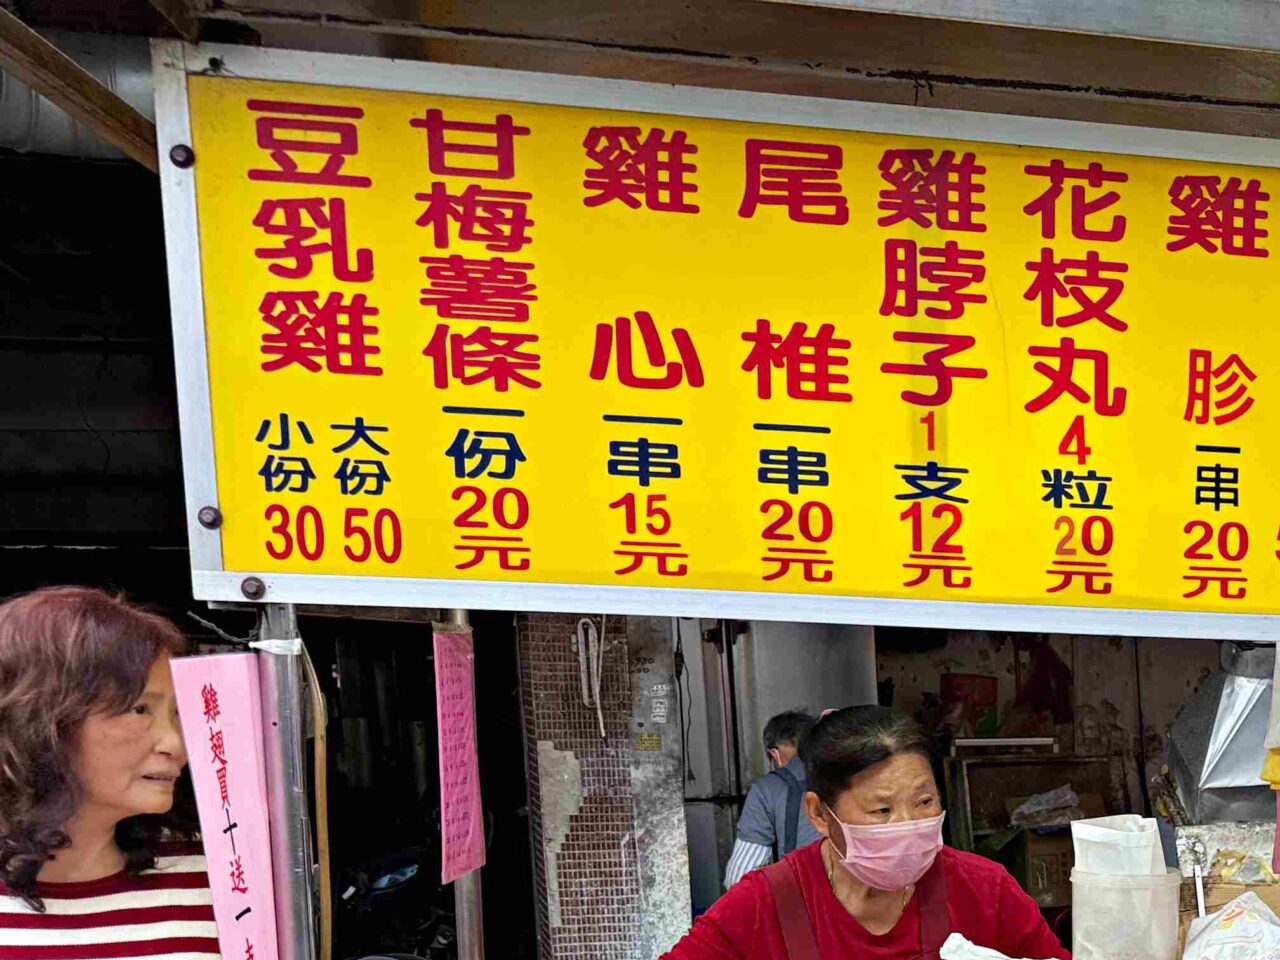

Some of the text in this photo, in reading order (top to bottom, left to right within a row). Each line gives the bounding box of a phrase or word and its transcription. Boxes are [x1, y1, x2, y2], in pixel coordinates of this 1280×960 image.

[246, 99, 402, 564] 豆乳雞 小份 30 大份 50
[410, 108, 542, 393] 甘梅薯條
[582, 126, 705, 390] 雞心
[738, 138, 853, 403] 尾椎
[877, 148, 988, 407] 雞脖子
[1023, 159, 1129, 416] 花枝丸
[1166, 175, 1270, 426] 雞胗
